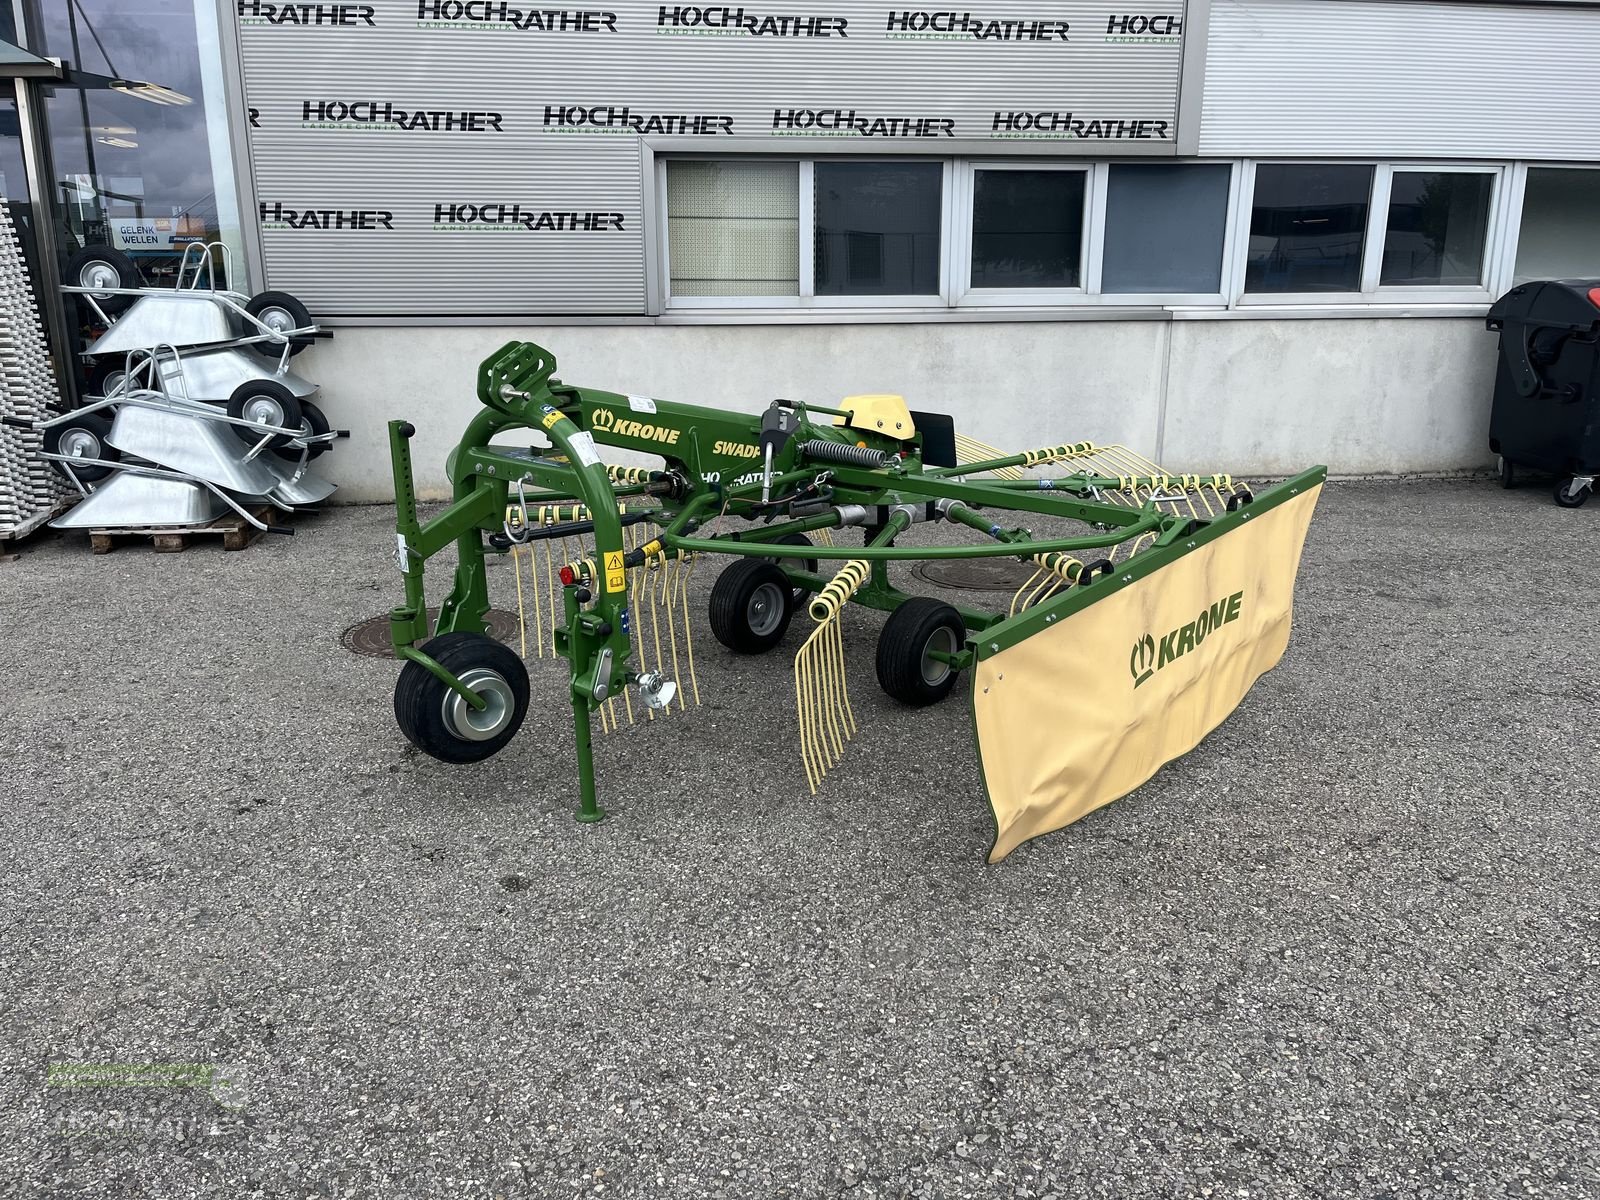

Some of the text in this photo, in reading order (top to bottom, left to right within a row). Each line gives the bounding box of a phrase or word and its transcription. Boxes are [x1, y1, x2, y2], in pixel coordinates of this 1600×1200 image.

[416, 21, 512, 31] LANDTECHNIK
[658, 6, 849, 38] HOCHRATHER
[886, 11, 1070, 42] HOCHRATHER
[1106, 15, 1182, 35] HOCH
[656, 28, 747, 37] LANDTECHNIK
[885, 33, 972, 41] LANDTECHNIK
[302, 101, 504, 132] HOCHRATHER
[543, 106, 735, 135] HOCHRATHER
[772, 109, 956, 137] HOCHRATHER
[991, 112, 1168, 139] HOCHRATHER
[301, 123, 398, 131] LANDTECHNIK
[542, 127, 634, 135] LANDTECHNIK
[771, 130, 858, 138] LANDTECHNIK
[990, 132, 1074, 140] LANDTECHNIK
[434, 203, 626, 232] HOCHRATHER
[120, 226, 155, 235] GELENK
[122, 235, 159, 244] WELLEN
[612, 418, 681, 445] KRONE
[1157, 589, 1244, 671] KRONE
